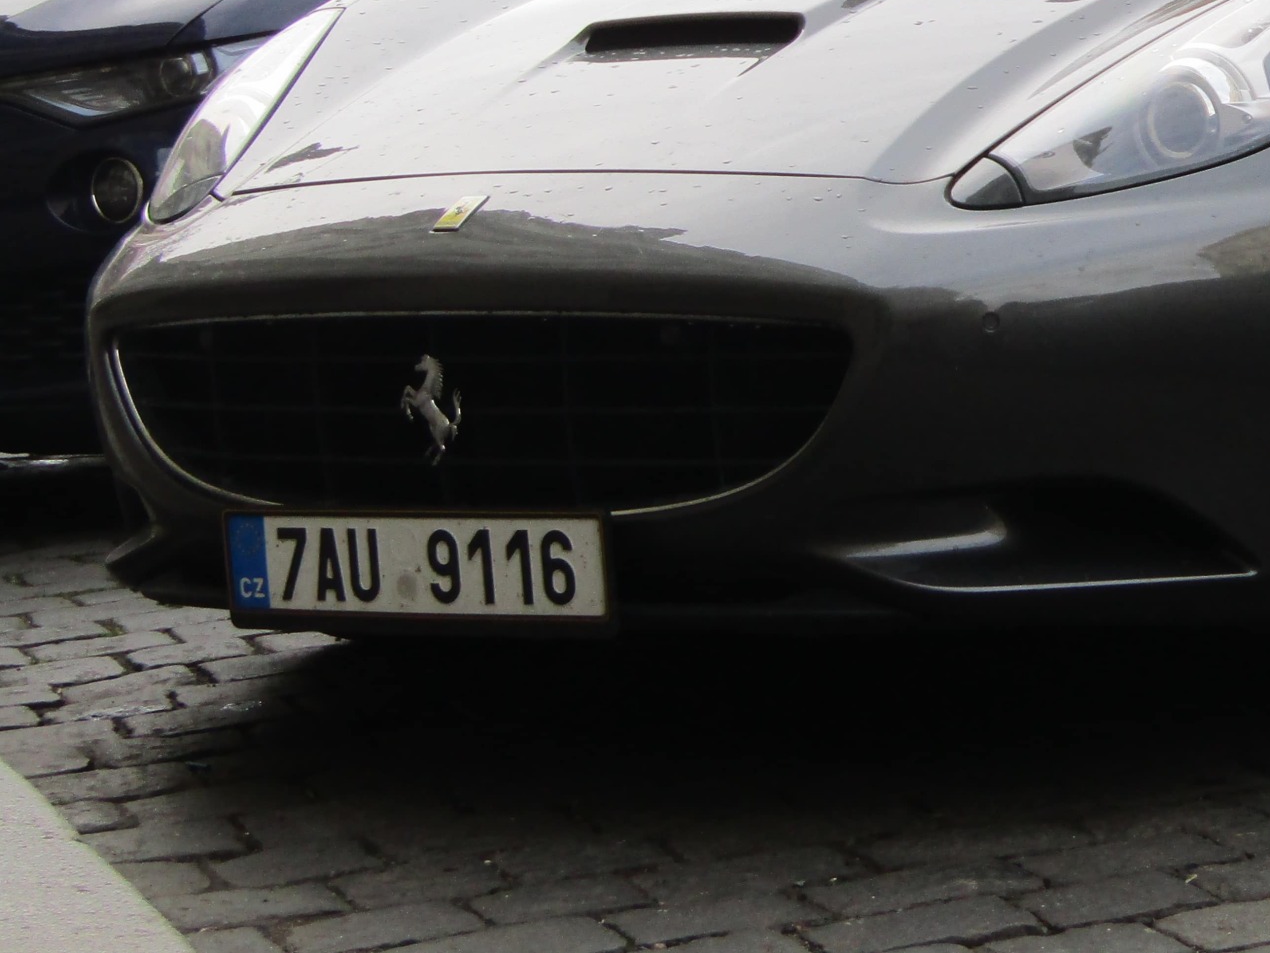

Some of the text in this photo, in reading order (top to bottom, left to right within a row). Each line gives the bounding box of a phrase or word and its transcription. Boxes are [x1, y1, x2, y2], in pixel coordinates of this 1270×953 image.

[239, 576, 266, 599] CZ
[276, 527, 576, 606] 7AU 9116
